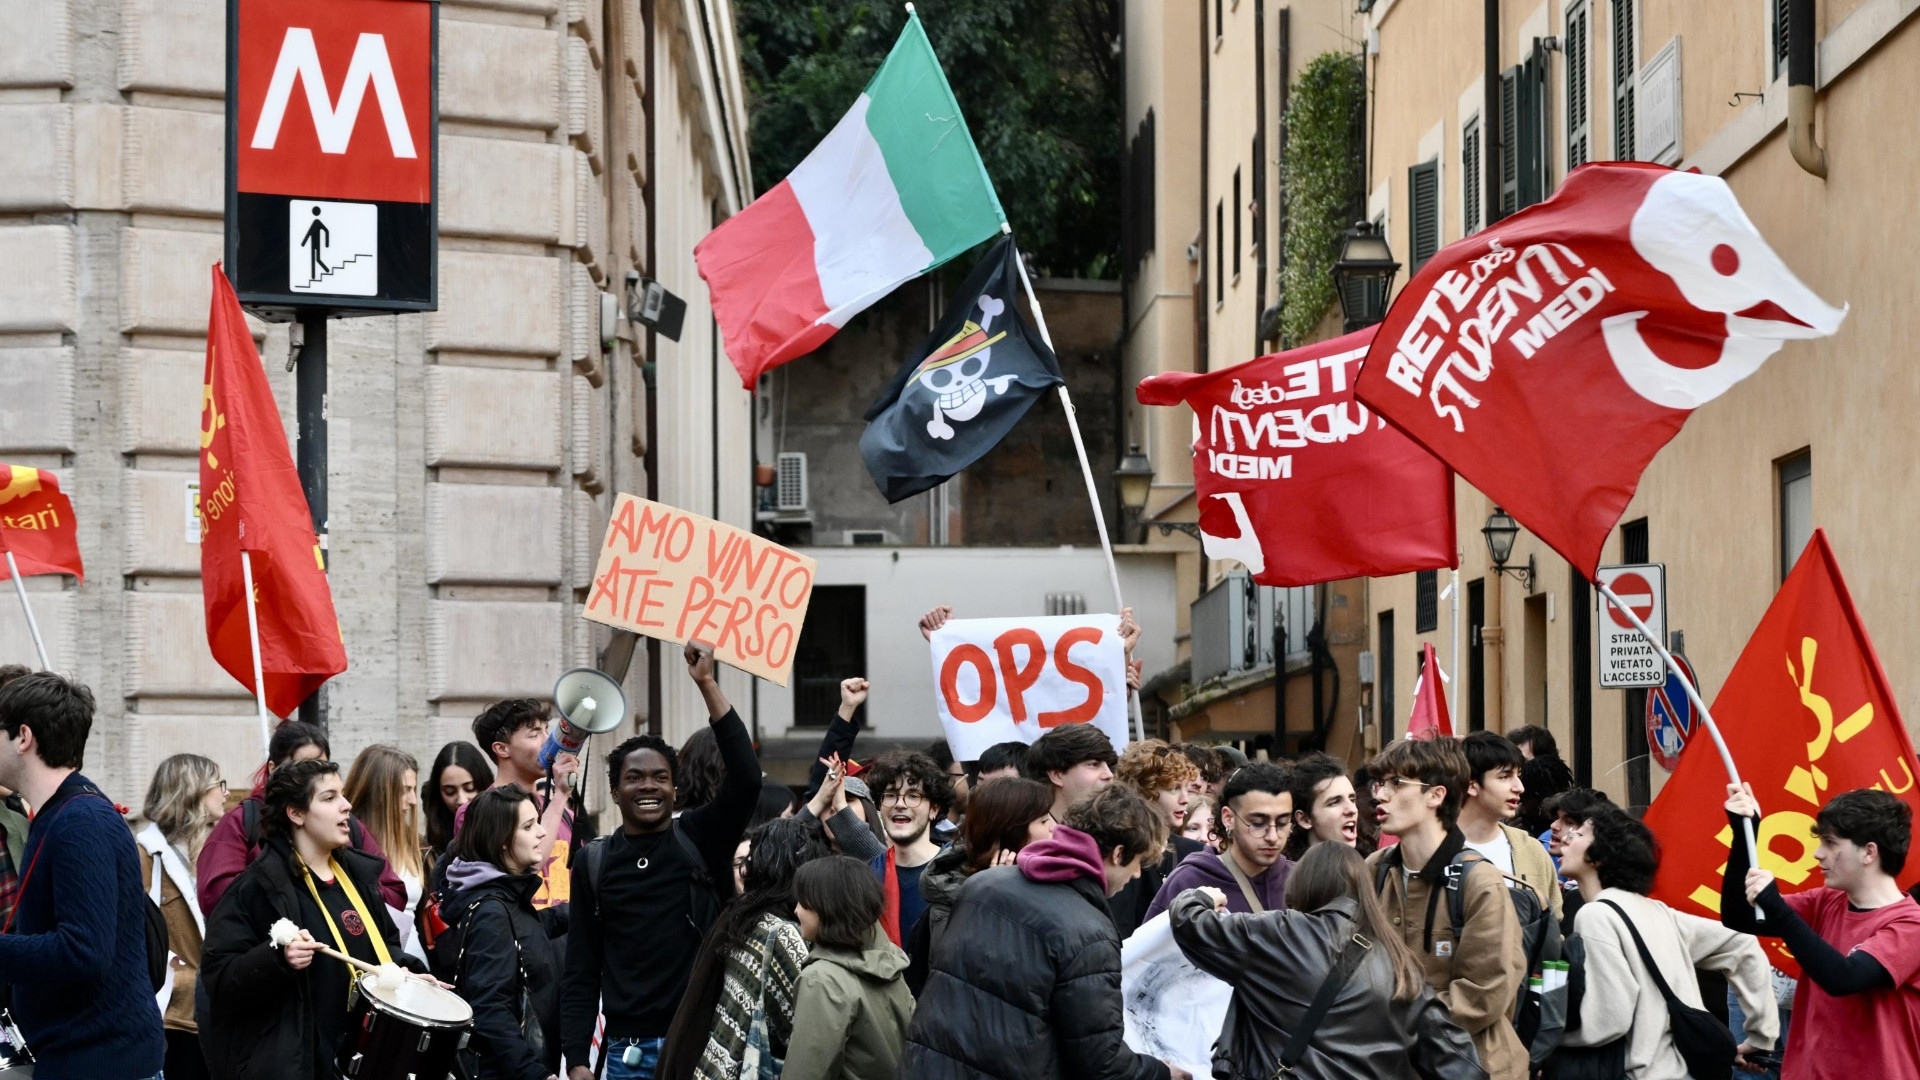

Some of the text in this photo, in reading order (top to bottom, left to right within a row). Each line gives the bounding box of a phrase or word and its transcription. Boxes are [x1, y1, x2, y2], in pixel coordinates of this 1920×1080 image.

[250, 26, 418, 159] M
[1386, 269, 1482, 398] RETE
[1429, 243, 1586, 432] STUDENTI
[1508, 267, 1617, 359] MEDI
[607, 499, 811, 610] AMO VINTO
[588, 555, 794, 669] ATE PERSO
[1610, 645, 1653, 656] PRIVATA
[1610, 658, 1653, 669] VIETATO
[1611, 633, 1649, 644] STRAD
[940, 626, 1104, 729] OPS
[1603, 671, 1661, 682] L'ACCESSO
